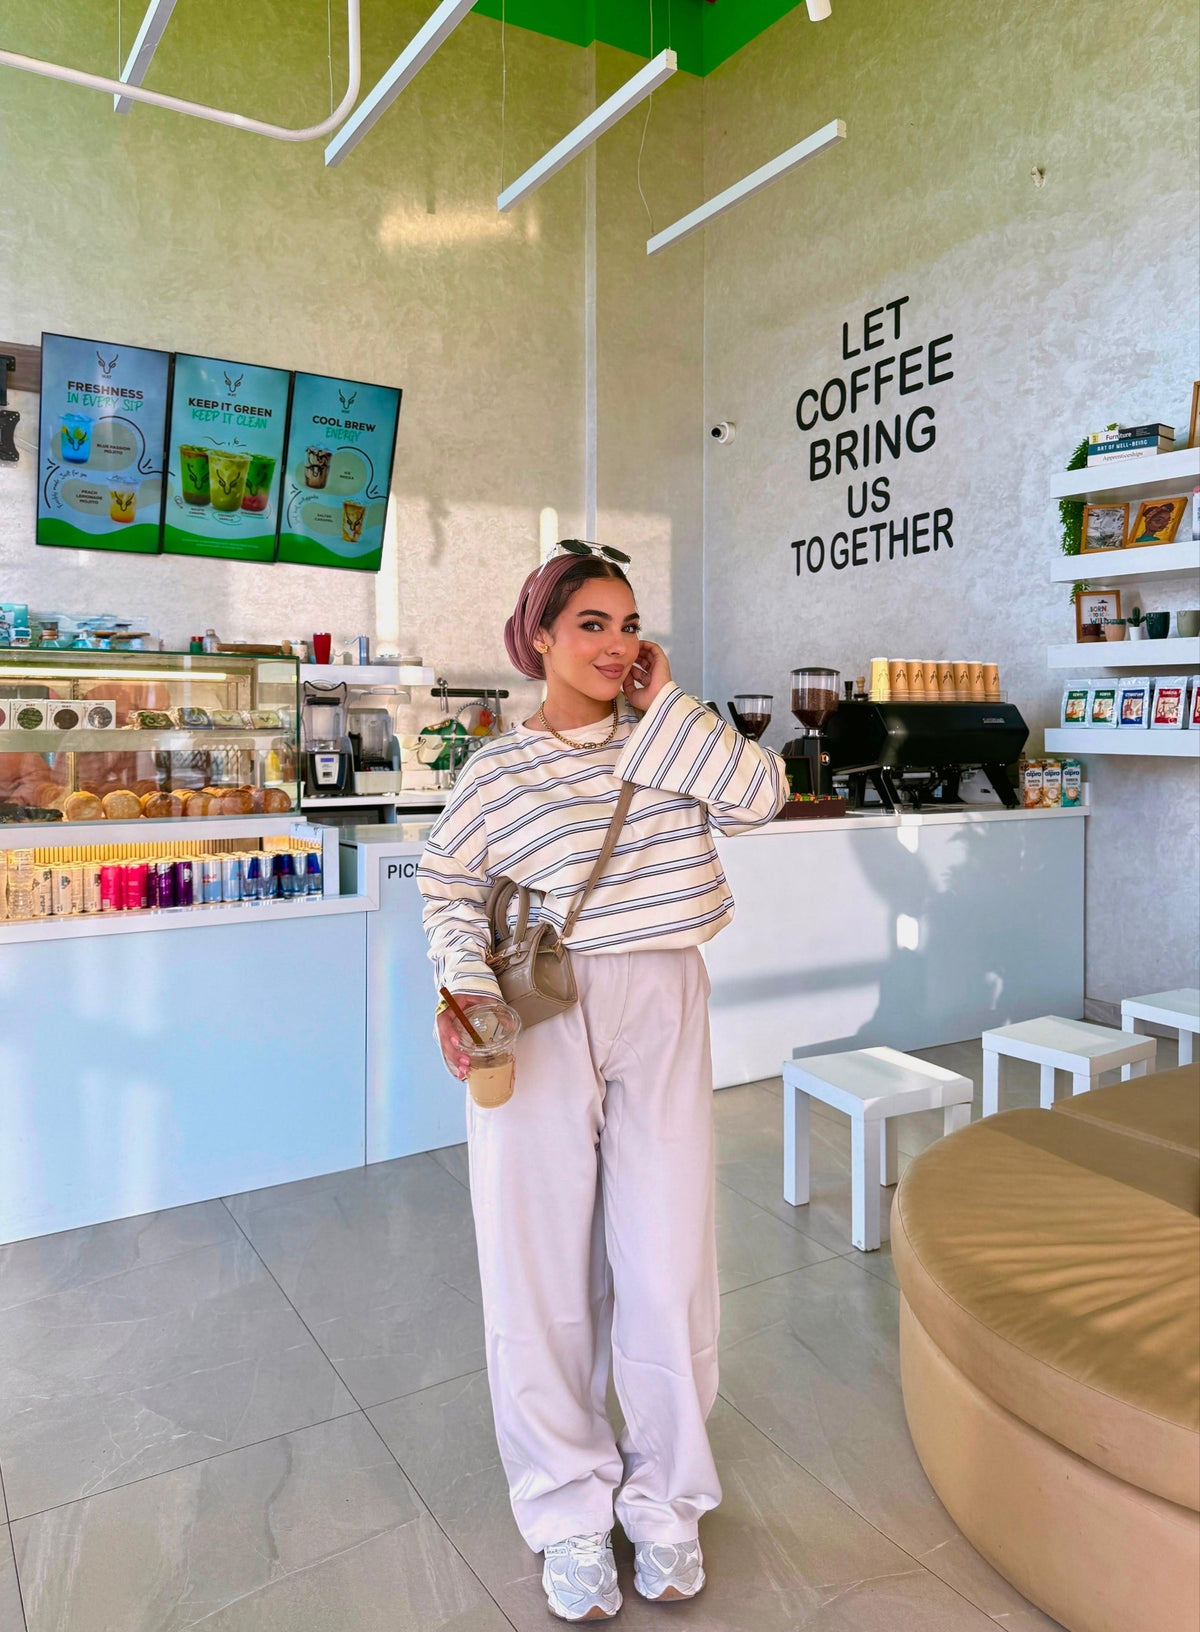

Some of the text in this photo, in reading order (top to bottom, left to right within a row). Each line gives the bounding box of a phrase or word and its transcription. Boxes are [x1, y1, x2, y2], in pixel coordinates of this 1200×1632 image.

[843, 296, 909, 360] LET
[67, 380, 144, 399] FRESHNESS
[796, 334, 954, 431] COFFEE
[67, 391, 144, 412] IN EVERY SIP
[188, 397, 272, 417] KEEP IT GREEN
[192, 408, 267, 429] KEEP IT CLEAN
[312, 415, 376, 432] COOL BREW
[325, 427, 362, 443] ENERGY
[810, 406, 936, 481] BRING
[1105, 432, 1132, 441] Furniture
[1116, 439, 1148, 449] WELL-BEING
[848, 477, 891, 518] US
[791, 508, 954, 576] TOGETHER
[1090, 605, 1107, 613] BORN
[1026, 770, 1041, 778] alpro
